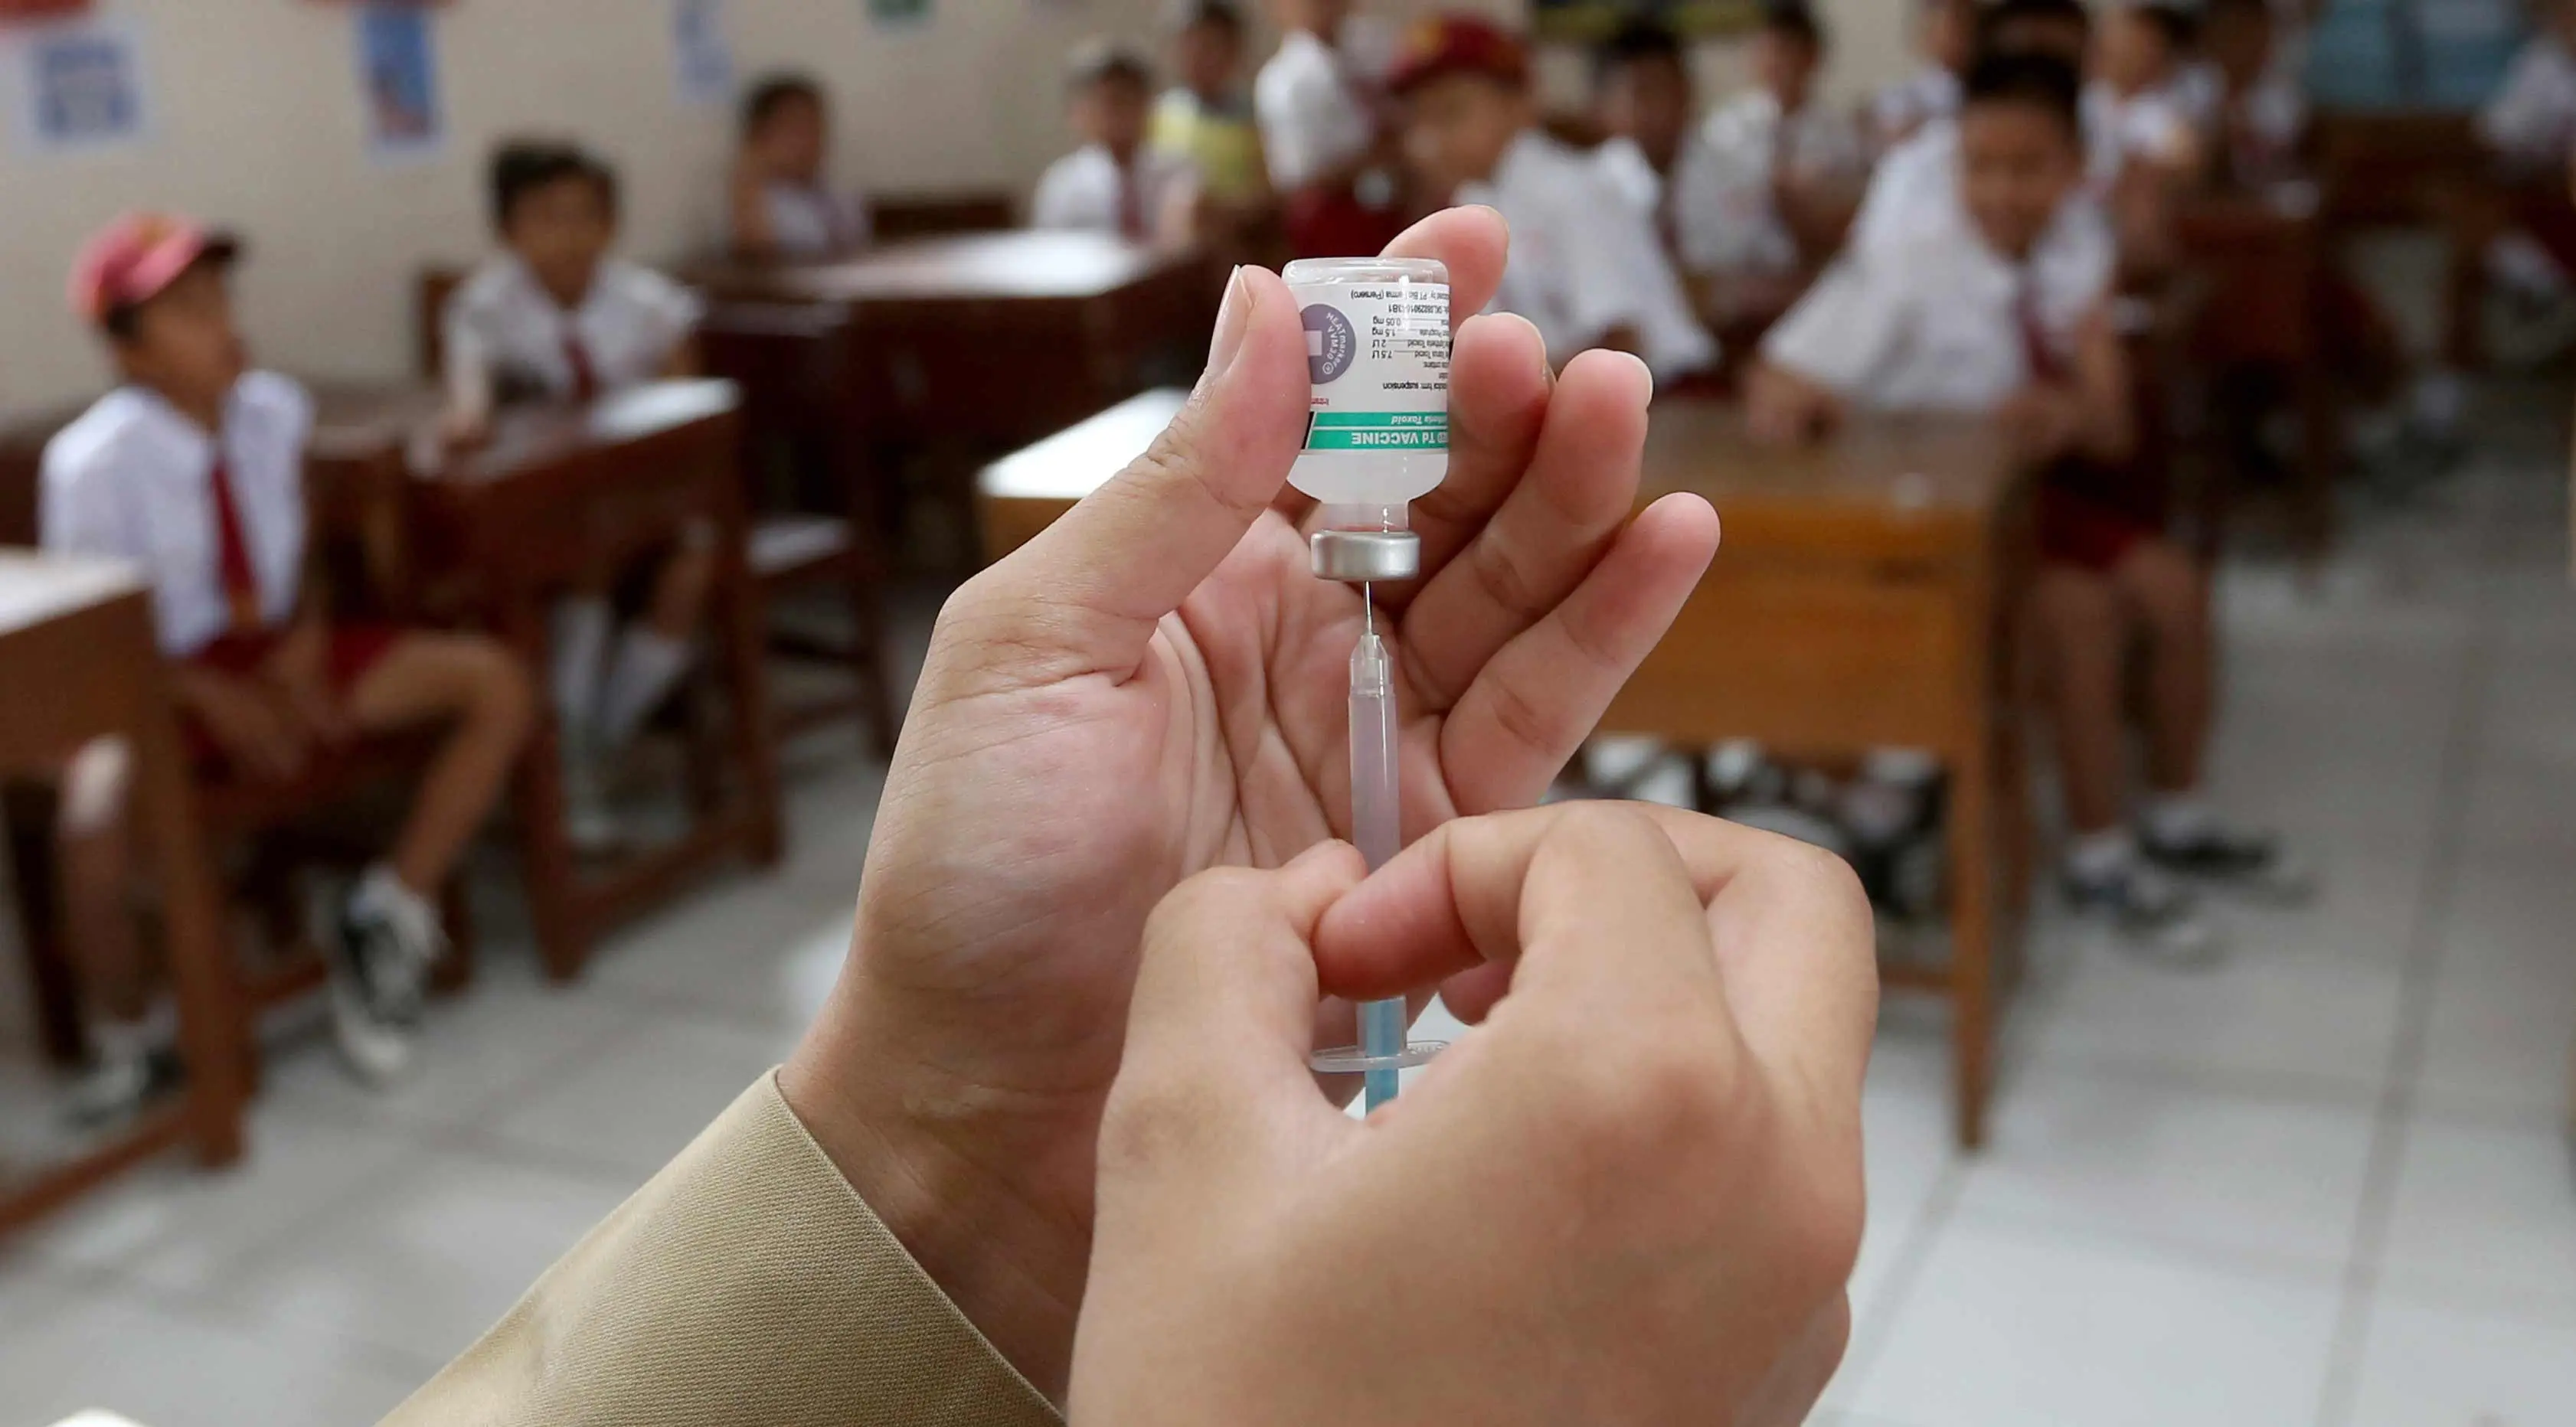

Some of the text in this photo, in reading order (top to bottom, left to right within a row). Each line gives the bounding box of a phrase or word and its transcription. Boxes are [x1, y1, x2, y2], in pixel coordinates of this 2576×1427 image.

[1351, 289, 1384, 300] (Persero)
[1386, 318, 1401, 326] 0.05
[1372, 328, 1384, 336] mg
[1385, 329, 1396, 338] 1.5
[1372, 339, 1380, 348] Lf
[1381, 339, 1387, 348] 2
[1372, 350, 1380, 359] Lf
[1381, 350, 1392, 359] 7.5
[1383, 381, 1419, 390] suspension
[1391, 416, 1423, 425] Toxoid
[1351, 432, 1419, 445] VACCINE
[1422, 432, 1436, 444] Td
